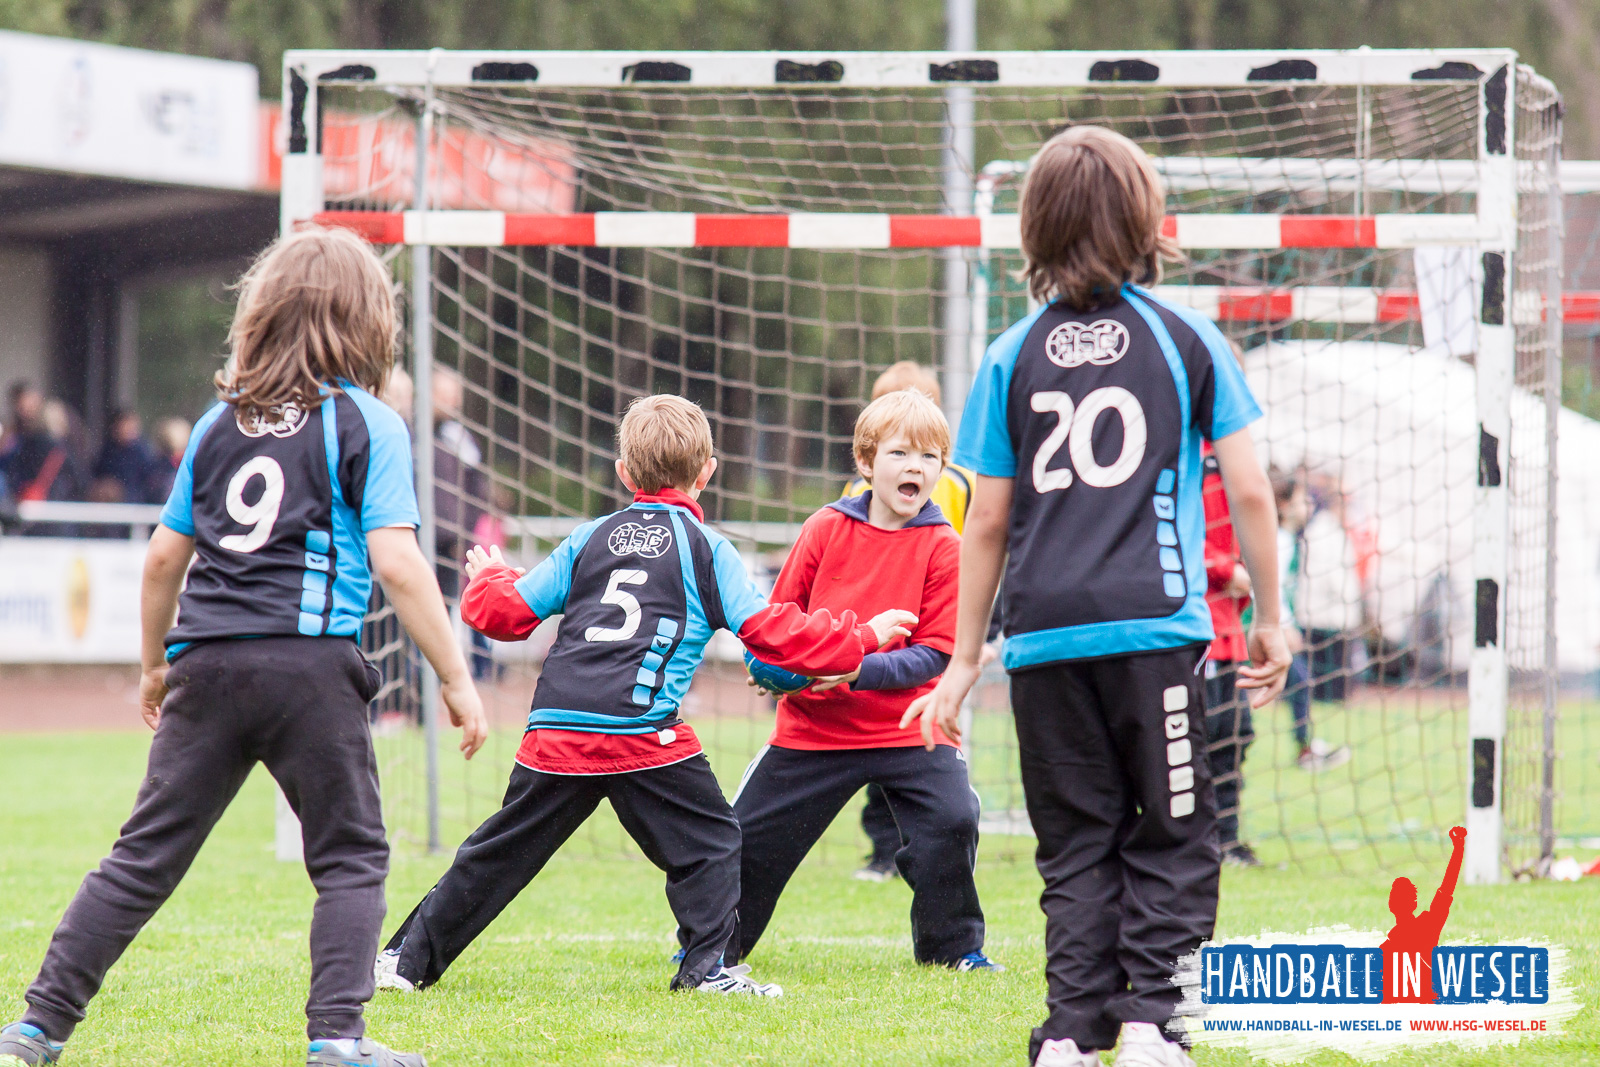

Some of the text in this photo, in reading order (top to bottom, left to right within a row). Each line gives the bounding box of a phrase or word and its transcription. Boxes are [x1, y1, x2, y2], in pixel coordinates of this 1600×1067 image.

[1030, 386, 1148, 494] 20
[218, 455, 285, 553] 9
[616, 528, 663, 548] HSG
[584, 568, 649, 642] 5
